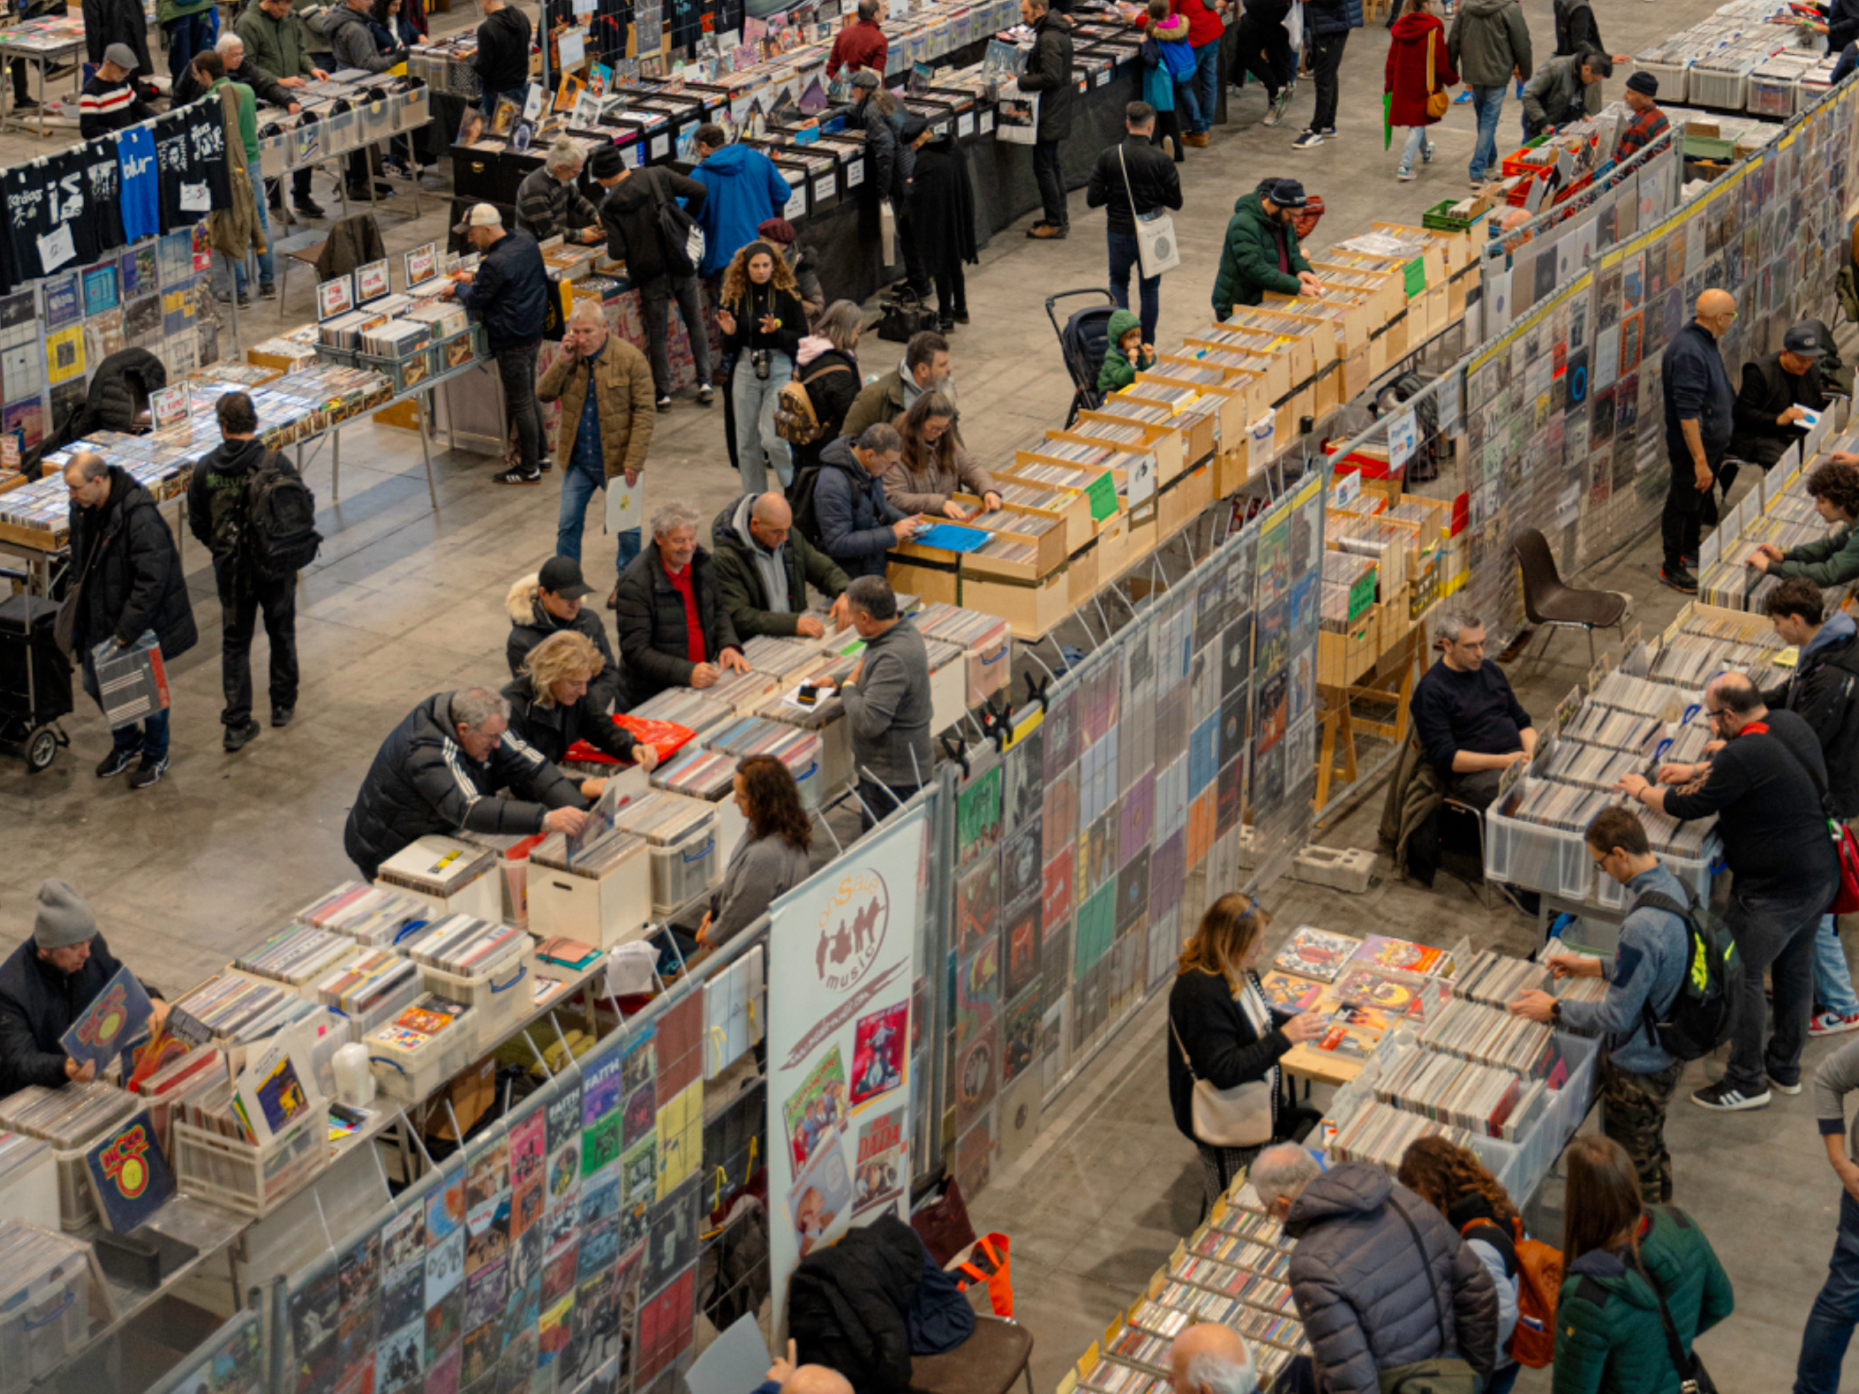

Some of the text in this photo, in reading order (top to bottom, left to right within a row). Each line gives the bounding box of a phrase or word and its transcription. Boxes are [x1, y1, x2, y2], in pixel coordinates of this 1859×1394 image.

[122, 154, 153, 180] blur
[413, 257, 432, 270] ROCK
[826, 944, 875, 990] music
[585, 1058, 620, 1091] FAITH
[550, 1087, 580, 1116] FAITH
[857, 1123, 901, 1165] DADA
